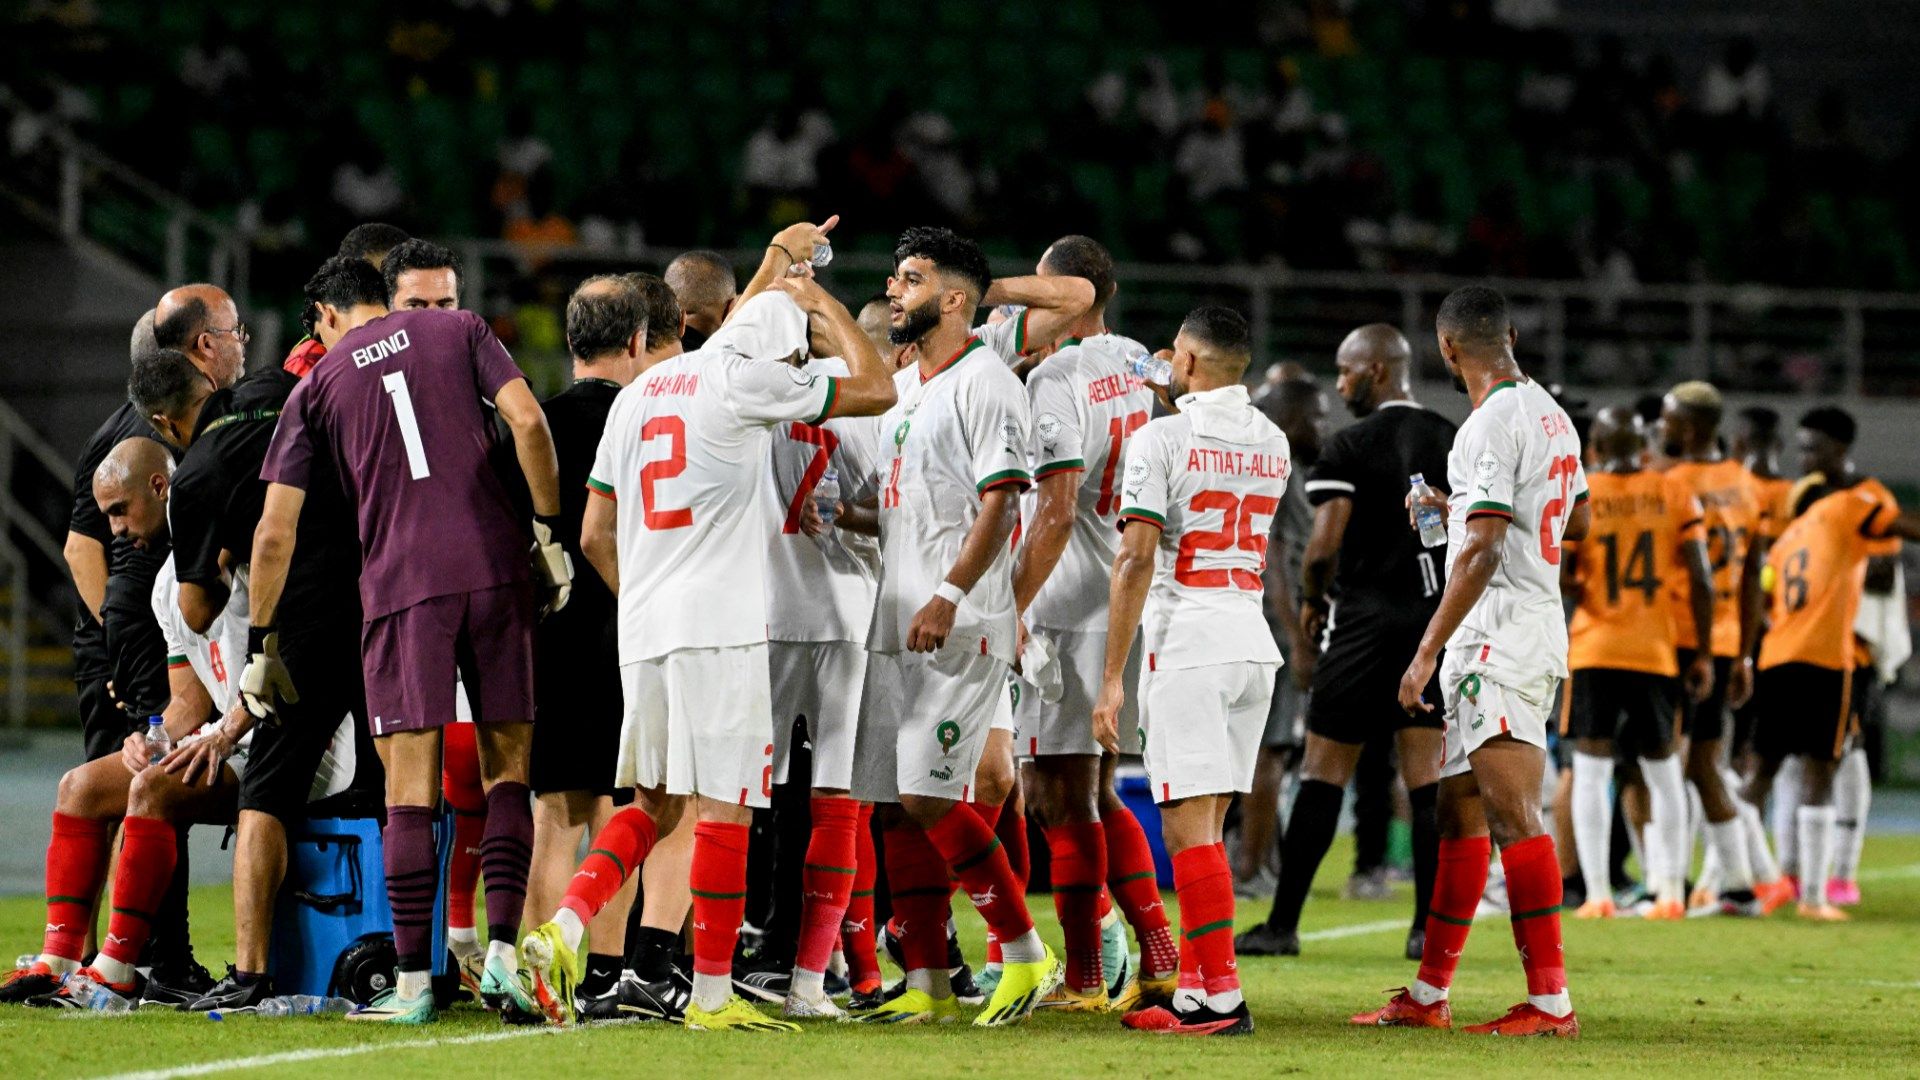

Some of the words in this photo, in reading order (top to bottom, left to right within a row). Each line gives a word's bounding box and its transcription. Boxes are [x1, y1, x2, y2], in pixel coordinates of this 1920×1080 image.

[352, 329, 410, 369] BONO
[643, 374, 698, 397] HAKIMI
[1088, 373, 1148, 406] ABDELHA
[382, 370, 430, 480] 1
[640, 415, 693, 531] 2
[783, 421, 839, 534] 7
[884, 457, 902, 509] 11
[1174, 489, 1280, 591] 25
[1598, 529, 1662, 606] 14
[209, 640, 228, 690] 4
